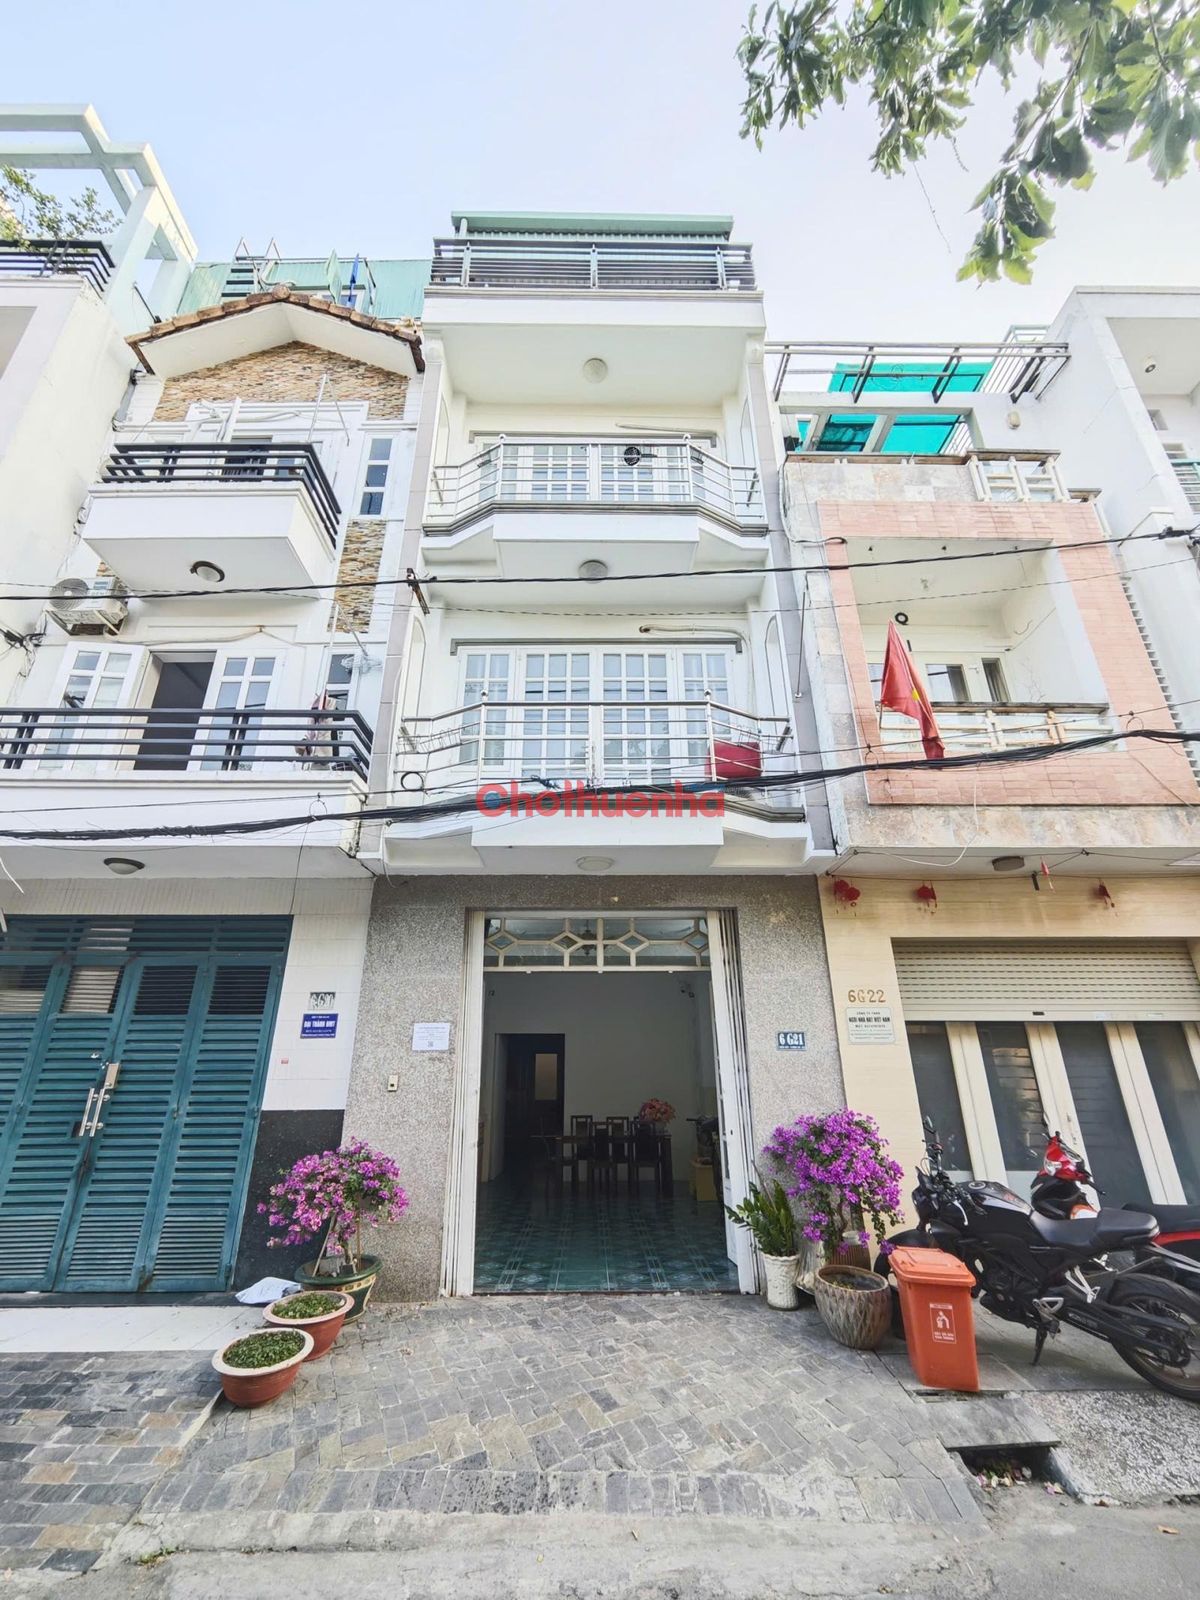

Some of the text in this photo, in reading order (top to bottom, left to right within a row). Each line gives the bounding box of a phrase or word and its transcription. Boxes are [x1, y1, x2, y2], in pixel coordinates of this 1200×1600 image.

[848, 989, 886, 1003] 6G22
[779, 1033, 803, 1046] 6 G21
